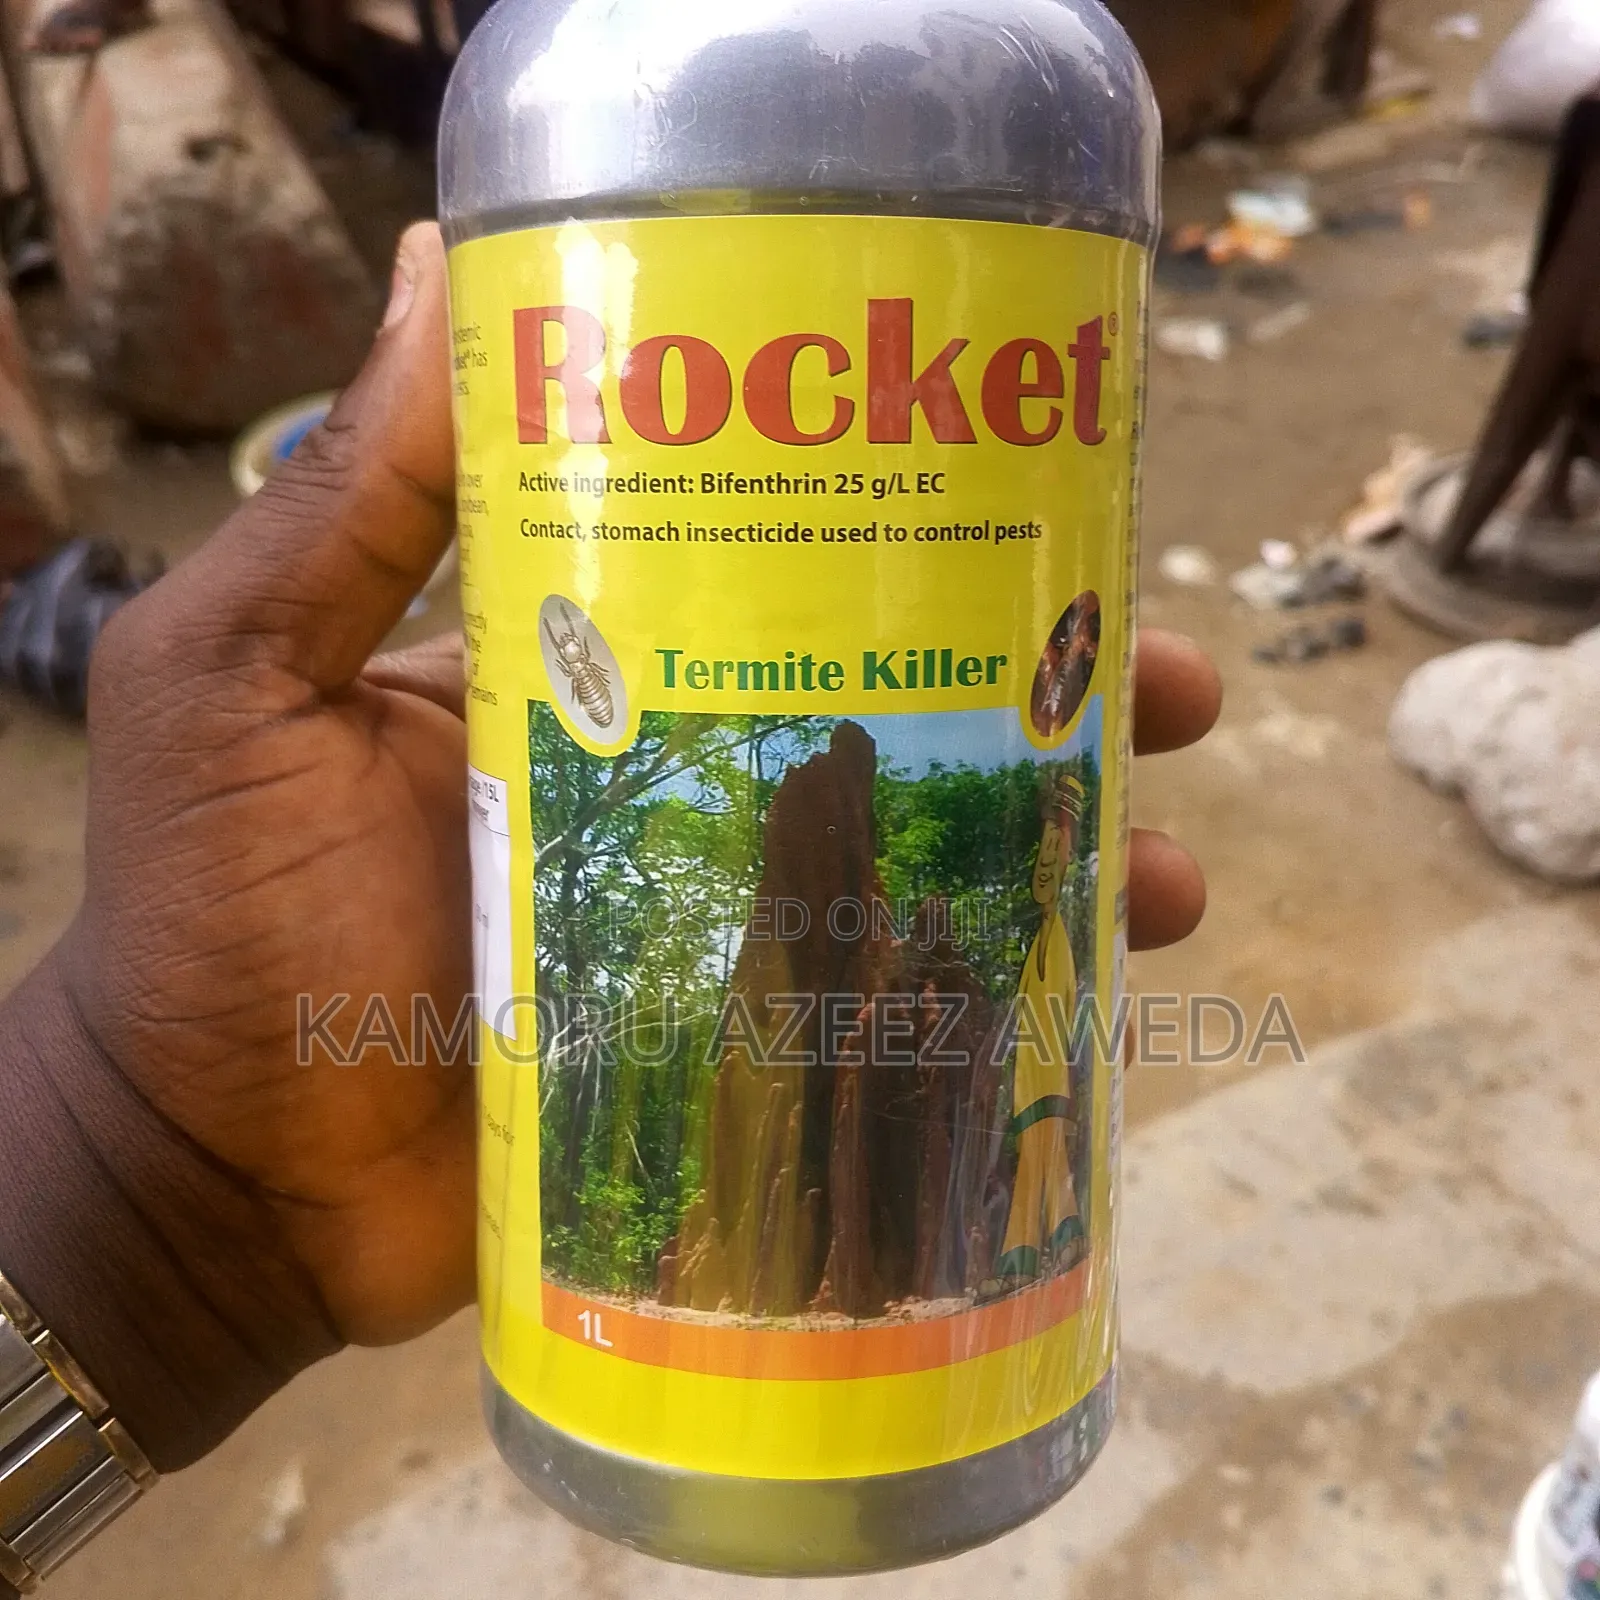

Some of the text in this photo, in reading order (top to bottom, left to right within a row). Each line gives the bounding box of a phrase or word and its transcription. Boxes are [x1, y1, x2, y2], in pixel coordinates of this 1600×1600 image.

[518, 471, 946, 500] Active ingredient: Bifenthrin 25 g/L EC
[520, 518, 1042, 545] Contact, stomach insecticide used to control pests
[655, 648, 1007, 692] Termite Killer
[577, 1309, 614, 1348] 1L
